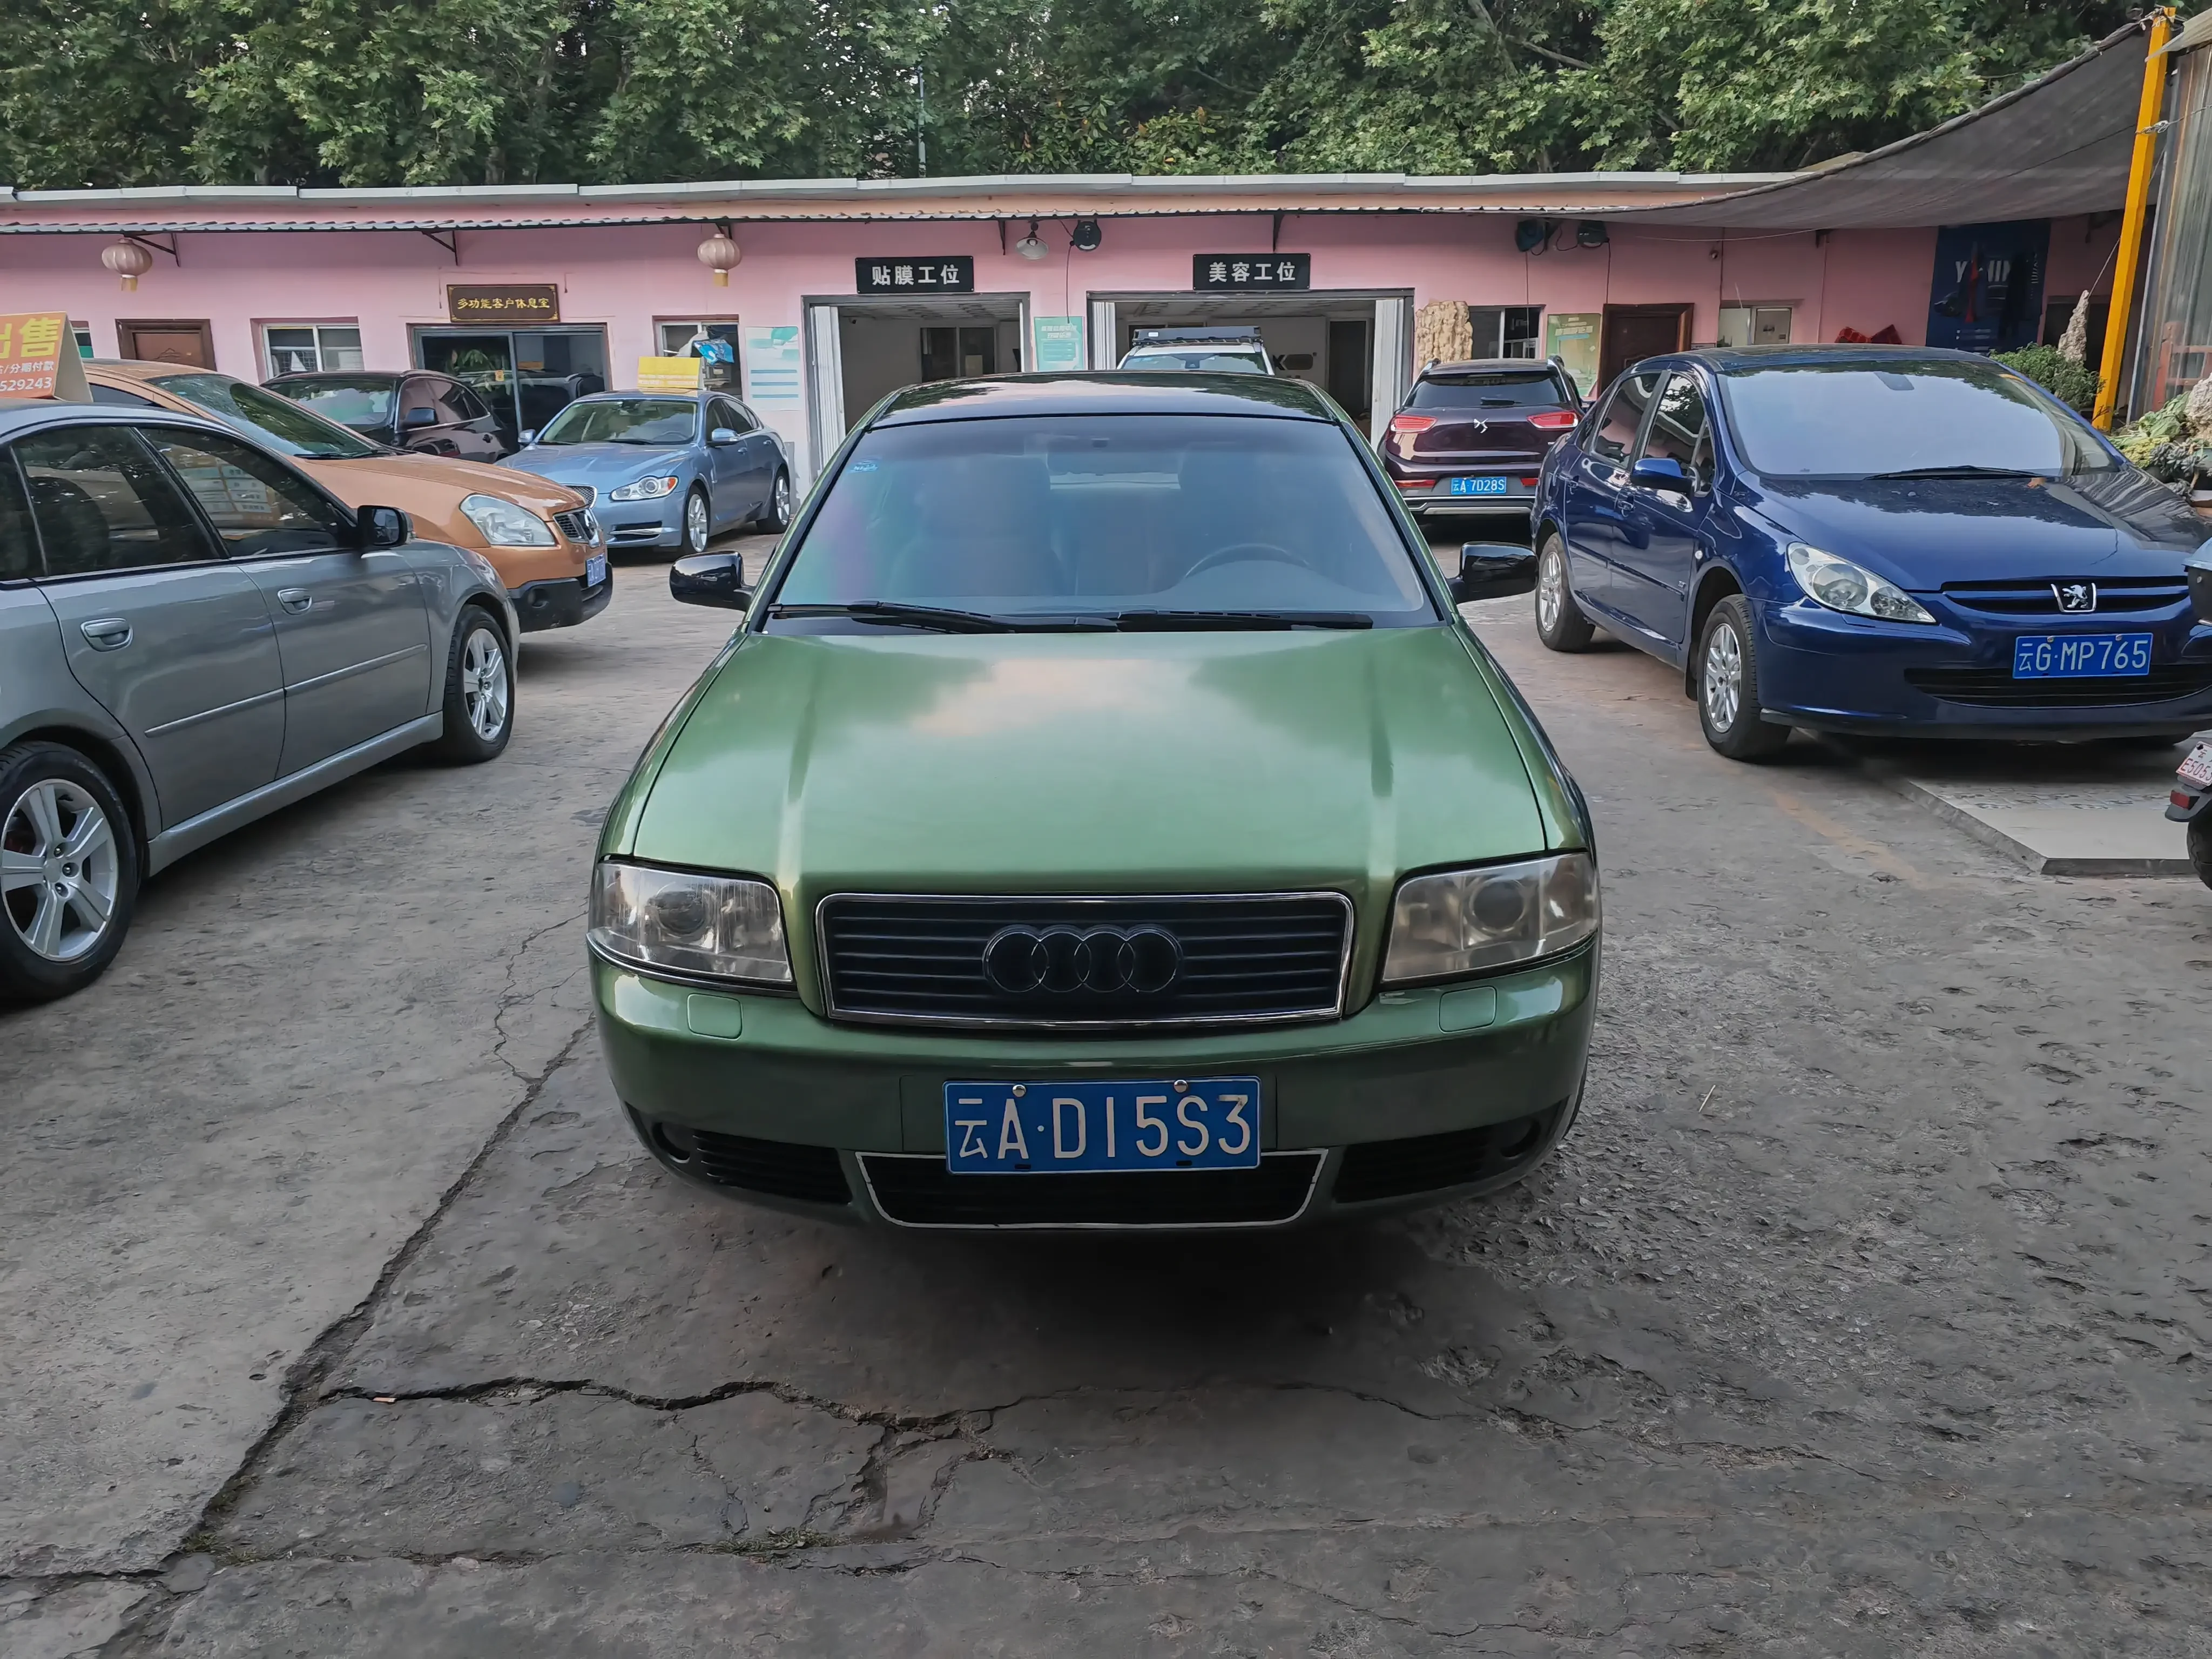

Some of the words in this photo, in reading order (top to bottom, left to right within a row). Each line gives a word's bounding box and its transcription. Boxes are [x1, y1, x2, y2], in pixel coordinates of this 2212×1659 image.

[872, 264, 960, 285] 贴膜工位
[1209, 261, 1296, 282] 美容工位
[457, 298, 550, 309] 多功能客户休息室
[0, 377, 52, 392] 529243
[2019, 640, 2148, 671] 云G·MP765
[955, 1094, 1251, 1159] 云A·D15S3
